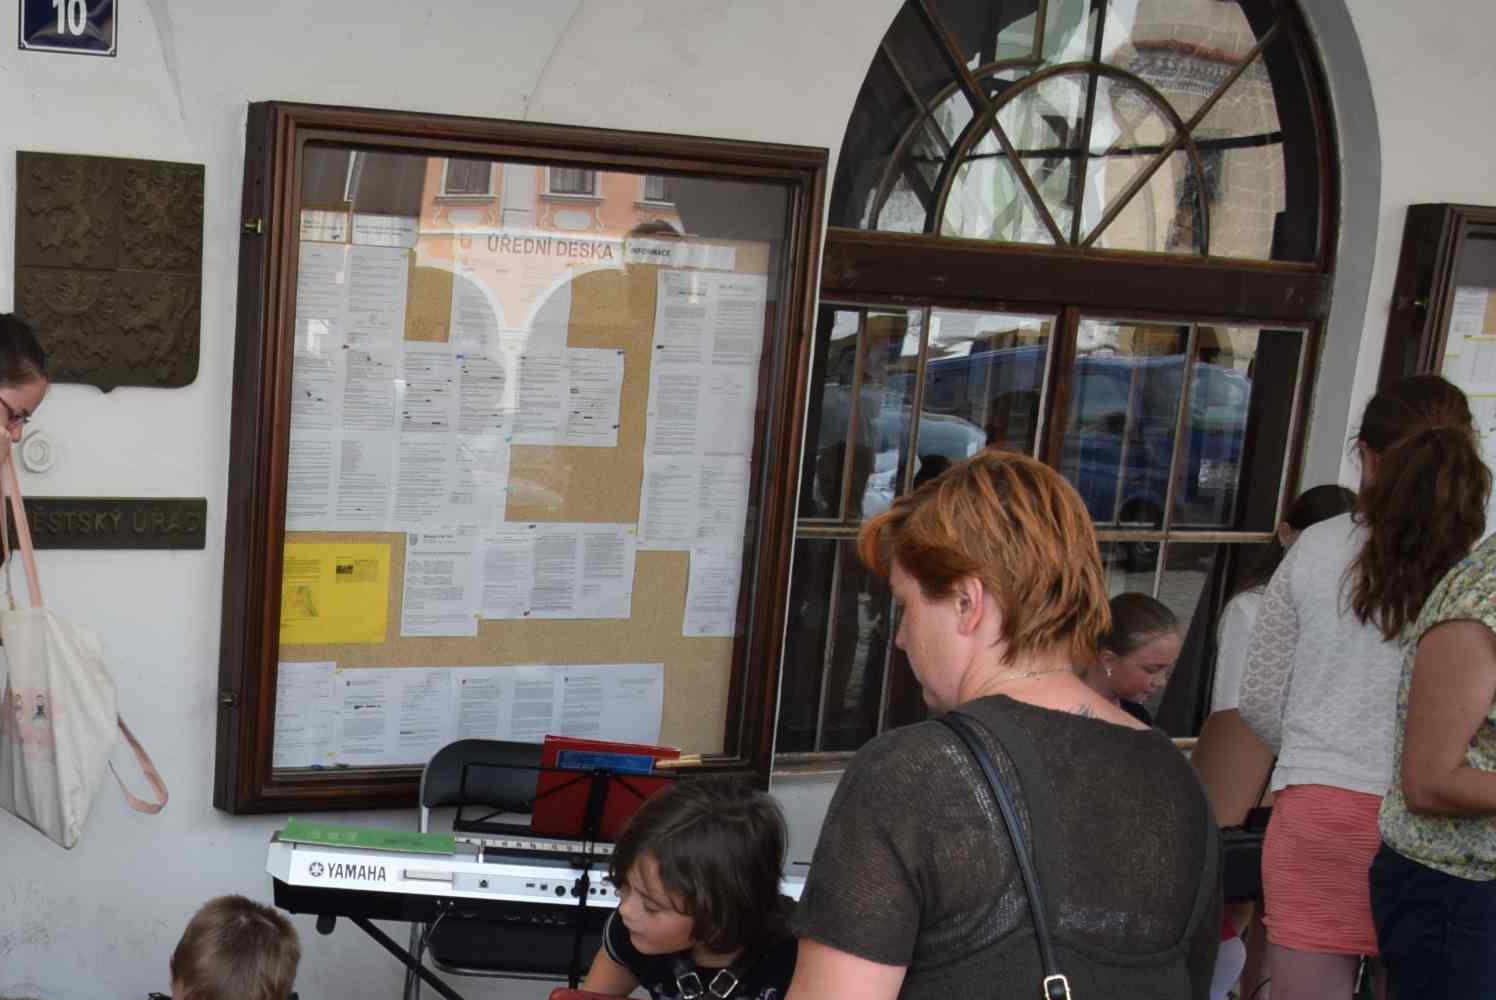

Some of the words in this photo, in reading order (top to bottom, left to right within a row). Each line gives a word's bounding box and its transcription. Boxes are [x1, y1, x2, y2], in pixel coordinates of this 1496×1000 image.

[52, 0, 87, 36] 10
[487, 232, 553, 256] ÚŘEDNÍ
[556, 239, 614, 260] DESKA
[327, 862, 386, 881] YAMAHA
